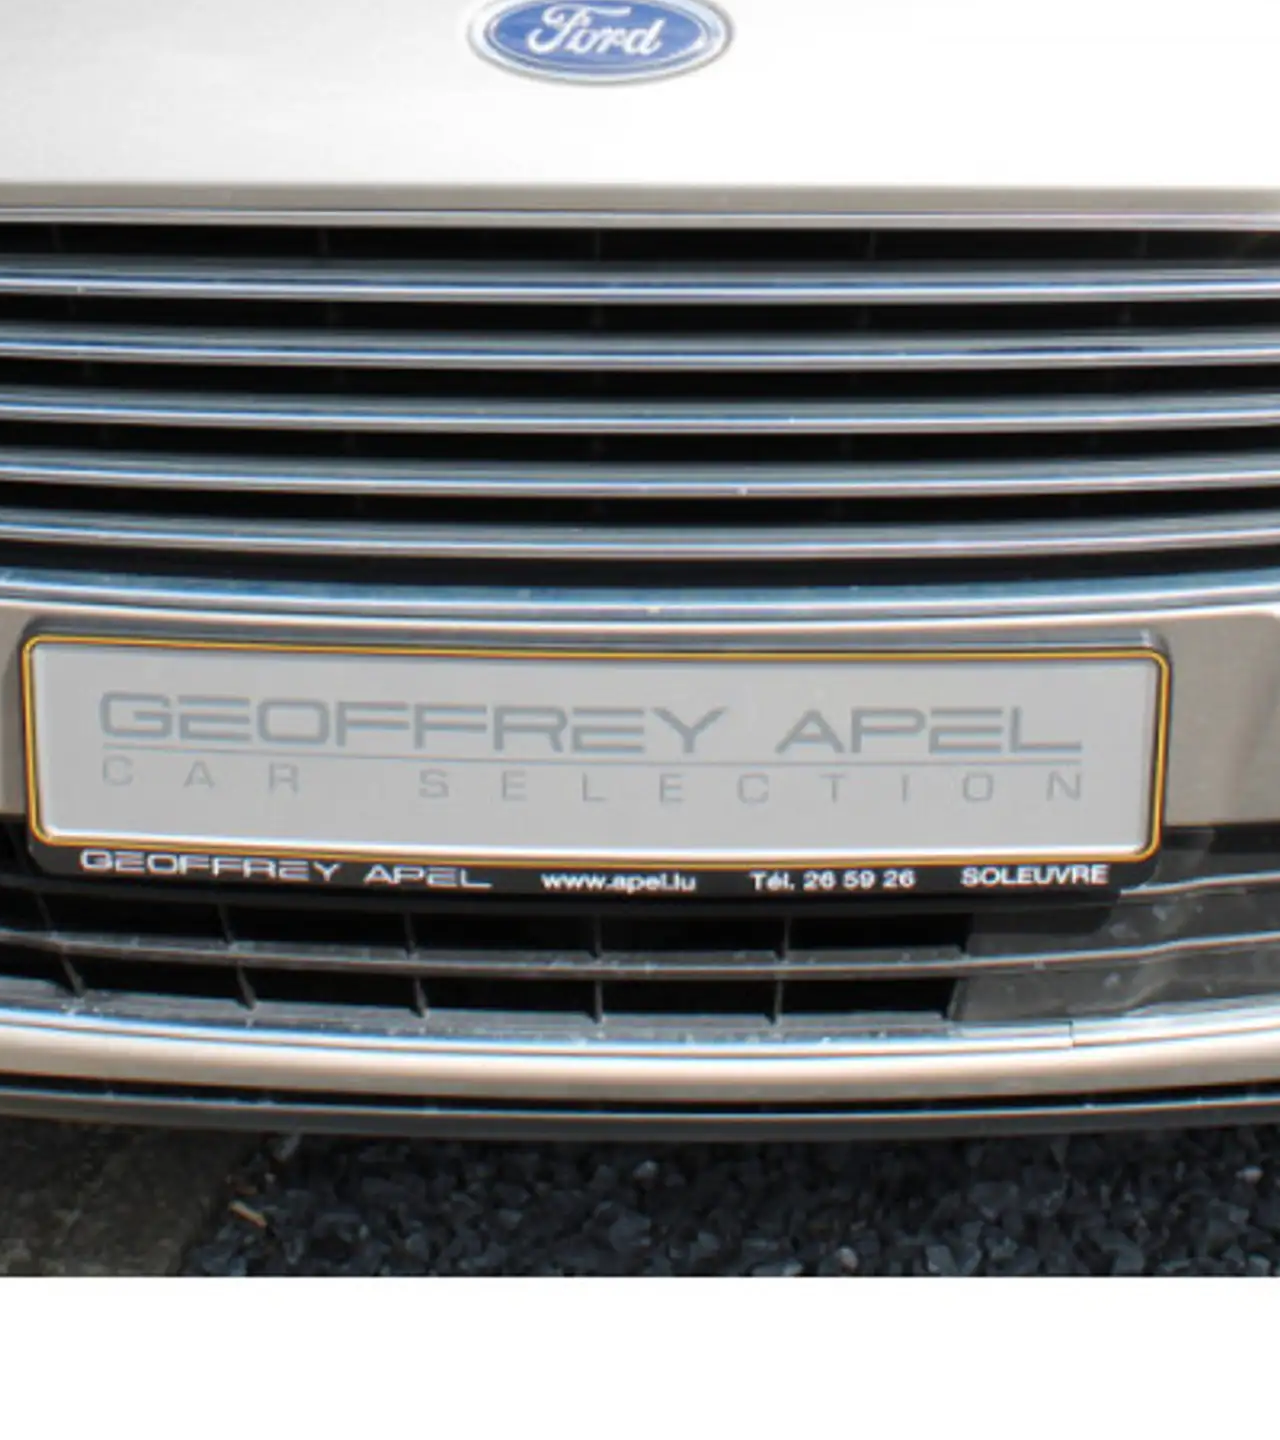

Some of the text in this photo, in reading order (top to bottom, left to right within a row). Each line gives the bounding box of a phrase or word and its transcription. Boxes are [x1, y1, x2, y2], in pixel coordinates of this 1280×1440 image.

[527, 3, 665, 56] Ford
[99, 691, 1082, 755] GEOFFREY APEL
[101, 755, 1082, 804] CAR SELECTION
[79, 848, 341, 883] GEOFFREY
[363, 863, 492, 889] APEL
[541, 871, 696, 894] www.apel.lu
[803, 869, 837, 891] 26
[842, 868, 876, 890] 59
[882, 867, 916, 889] 26
[960, 863, 1110, 888] SOLEUVRE
